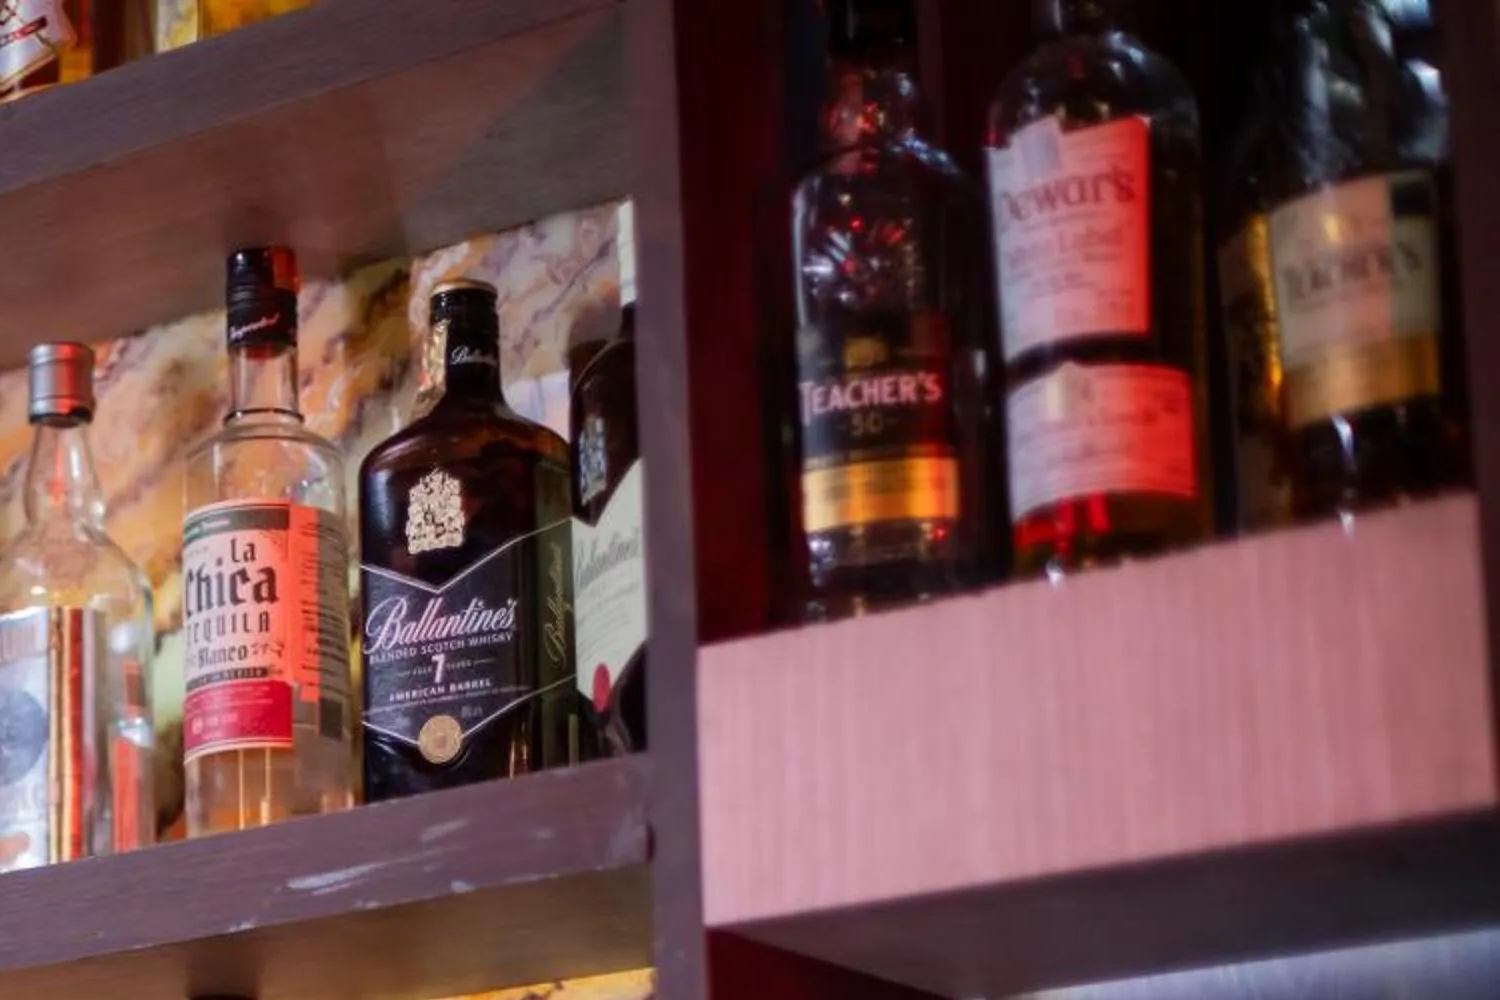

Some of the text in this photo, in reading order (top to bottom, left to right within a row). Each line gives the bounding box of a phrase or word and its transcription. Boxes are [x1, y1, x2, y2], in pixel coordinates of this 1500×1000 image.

[799, 371, 943, 427] TEACHER'S
[230, 537, 257, 563] La
[184, 556, 279, 618] Chica
[363, 596, 518, 656] Ballantine's
[369, 631, 513, 666] BLENDED SCOTCH WHISKY
[431, 653, 446, 684] 7
[389, 677, 492, 702] AMERICAN BARREL
